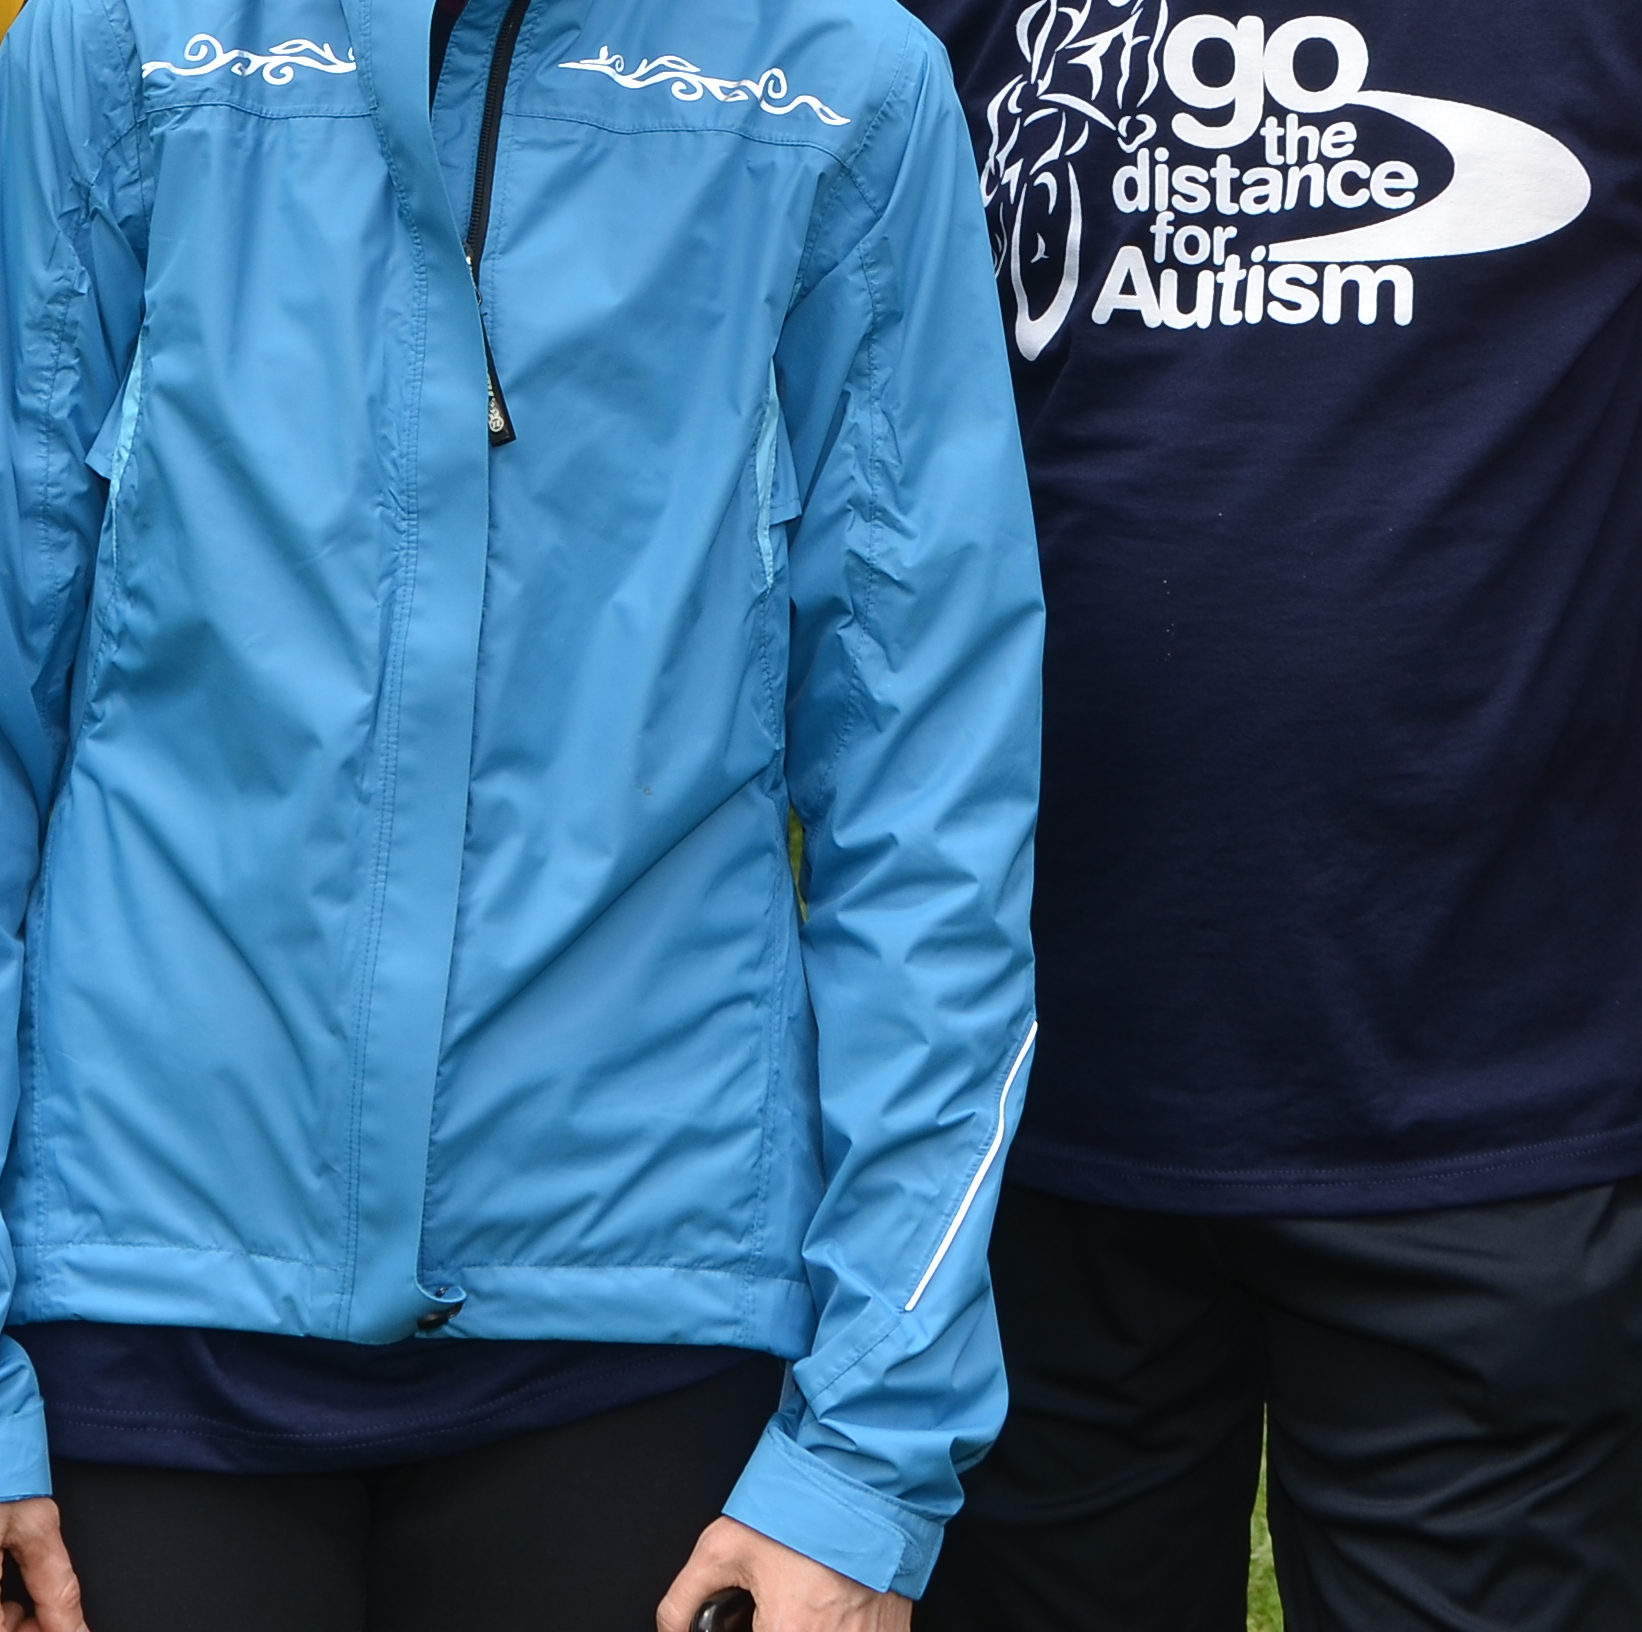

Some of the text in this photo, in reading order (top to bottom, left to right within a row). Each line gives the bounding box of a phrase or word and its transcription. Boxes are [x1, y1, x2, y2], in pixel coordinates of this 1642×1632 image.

[1163, 14, 1369, 148] go
[1261, 114, 1357, 164] the
[1113, 147, 1419, 216] distance
[1149, 211, 1238, 265] for
[1091, 244, 1414, 330] Autism
